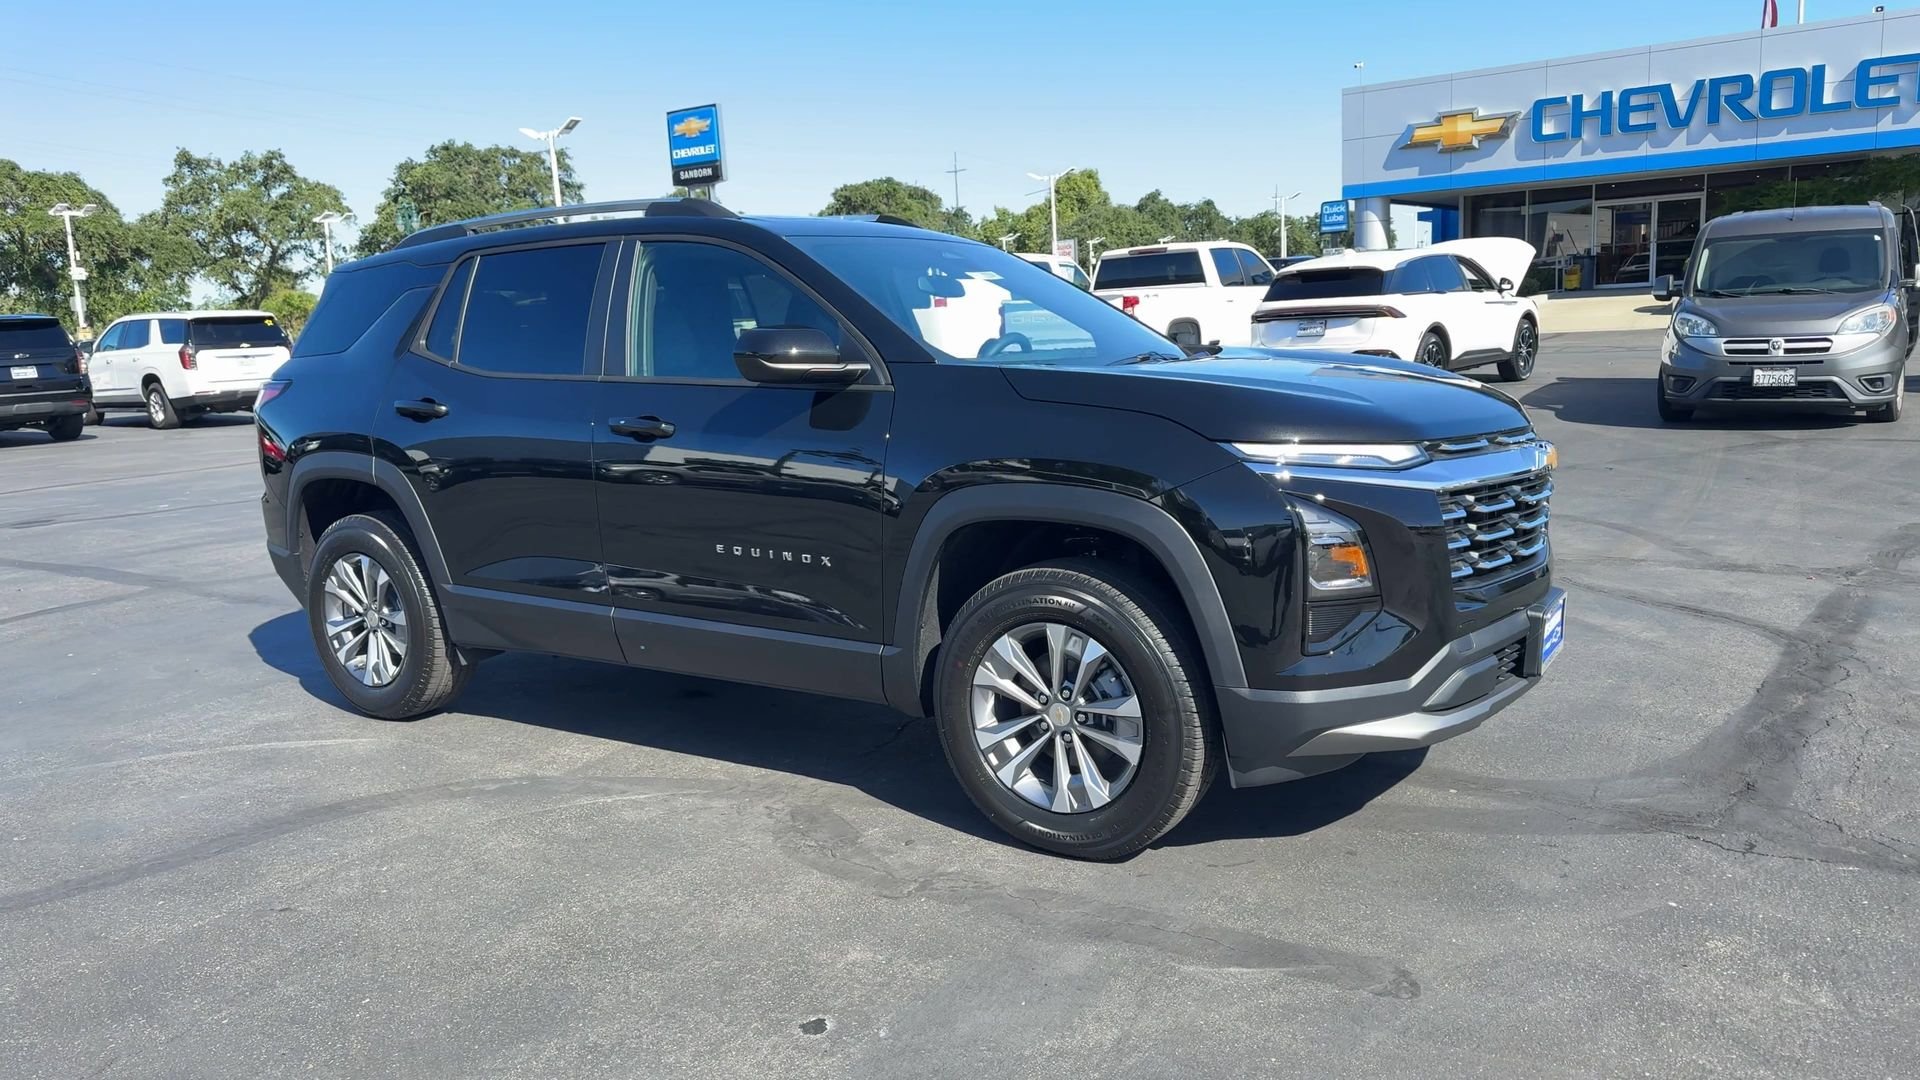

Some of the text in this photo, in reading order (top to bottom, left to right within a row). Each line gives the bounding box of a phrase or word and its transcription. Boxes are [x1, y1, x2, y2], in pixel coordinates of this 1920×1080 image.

[673, 144, 715, 158] CHEVROLET
[680, 167, 712, 179] SANBORN
[1323, 204, 1345, 213] Quick
[1324, 213, 1344, 222] Lube
[715, 544, 831, 567] EQUINOX
